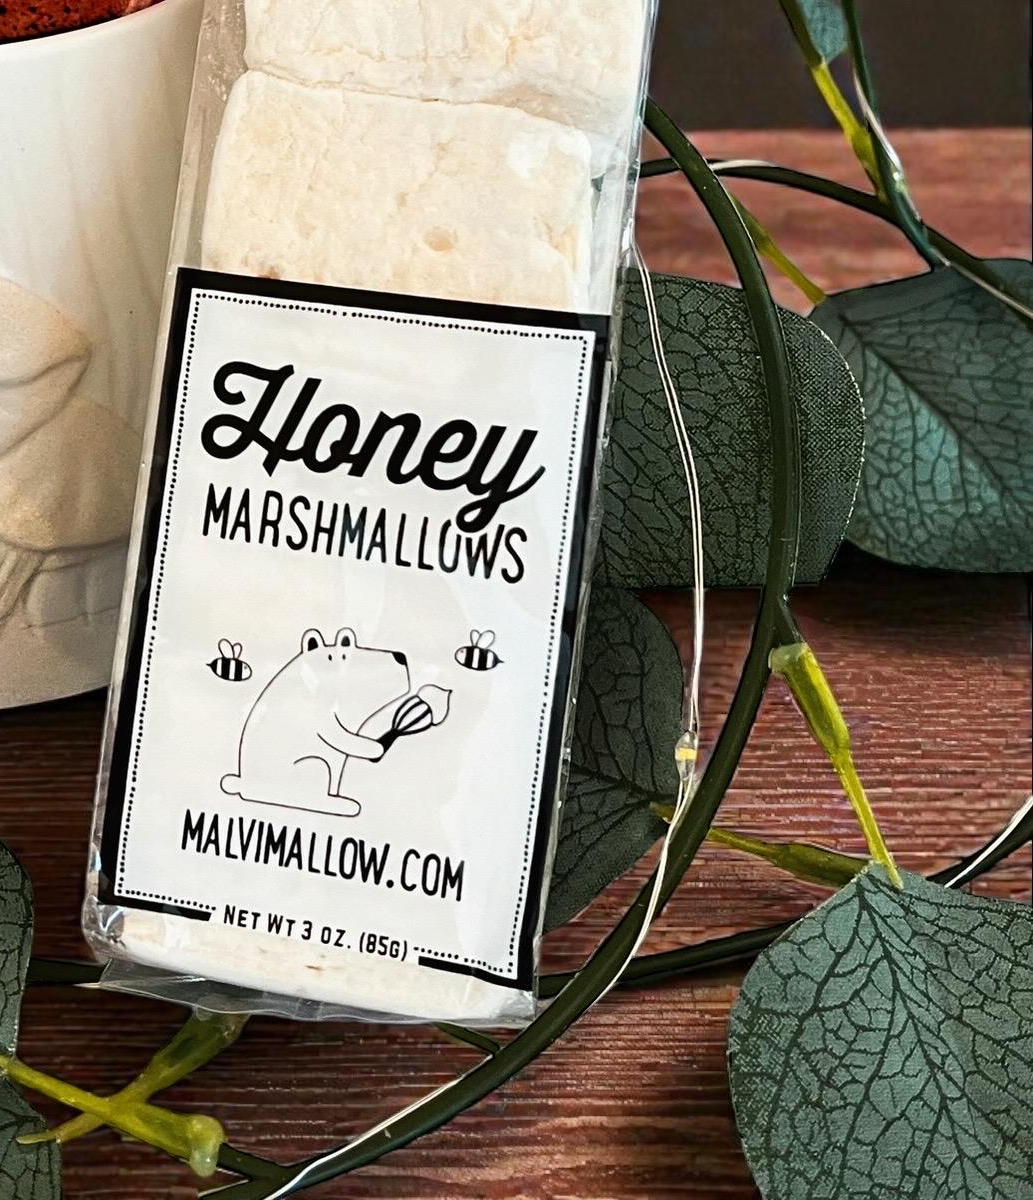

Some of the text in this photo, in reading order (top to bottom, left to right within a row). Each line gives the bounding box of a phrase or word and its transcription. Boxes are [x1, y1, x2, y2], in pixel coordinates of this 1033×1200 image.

[201, 360, 547, 534] Honey
[202, 483, 528, 584] MARSHMALLOWS
[181, 808, 465, 902] MALVIMALLOW.COM
[223, 904, 408, 962] NET WT 3 OZ. (85G)
